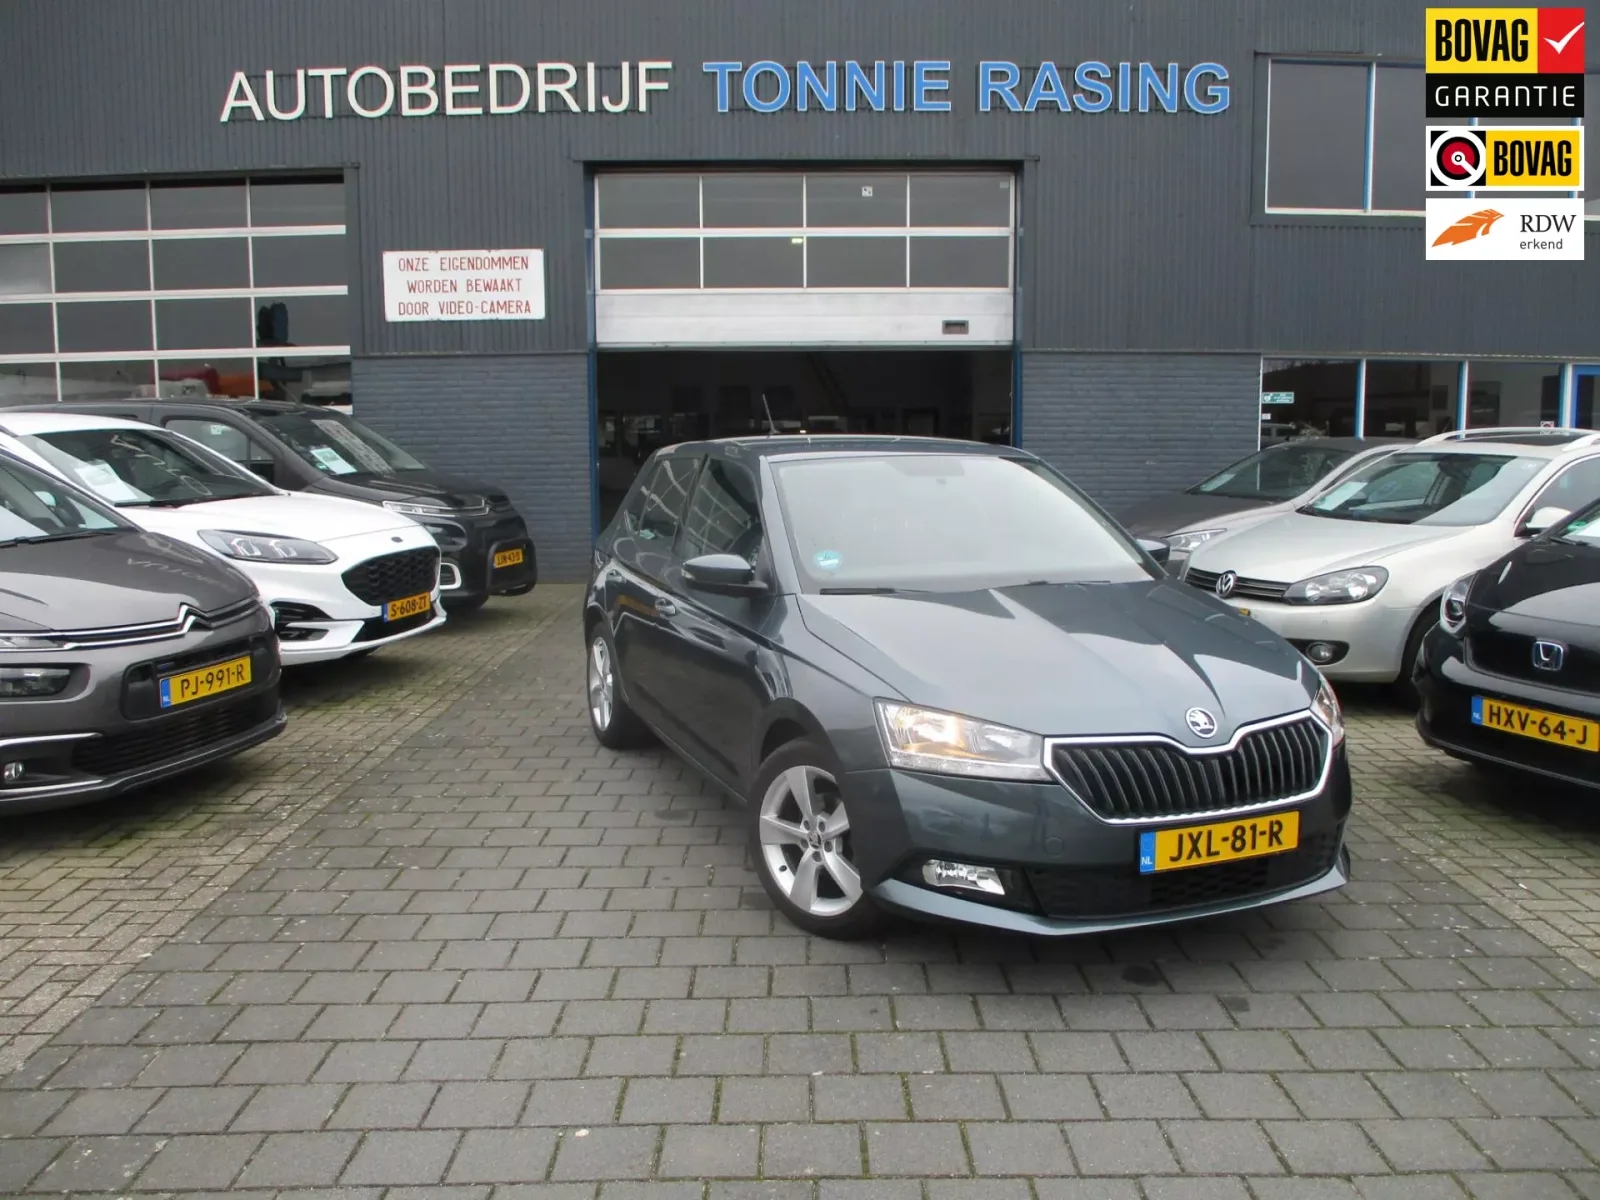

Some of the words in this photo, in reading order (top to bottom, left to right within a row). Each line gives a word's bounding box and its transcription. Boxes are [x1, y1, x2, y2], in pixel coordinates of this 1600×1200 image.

[220, 60, 673, 122] AUTOBEDRIJF
[702, 60, 952, 112] TONNIE
[979, 60, 1231, 115] RASING
[398, 257, 429, 272] ONZE
[440, 256, 529, 271] EIGENDOMMEN
[407, 279, 458, 294] WORDEN
[466, 278, 522, 293] BEWAAKT
[398, 302, 430, 316] DOOR
[439, 300, 532, 315] VIDEO-CAMERA
[390, 595, 428, 617] S-608-ZT
[180, 663, 245, 698] PJ-991-R
[1488, 704, 1588, 744] HXV-64-J
[1141, 855, 1153, 865] NL
[1169, 819, 1284, 863] JXL-81-R
